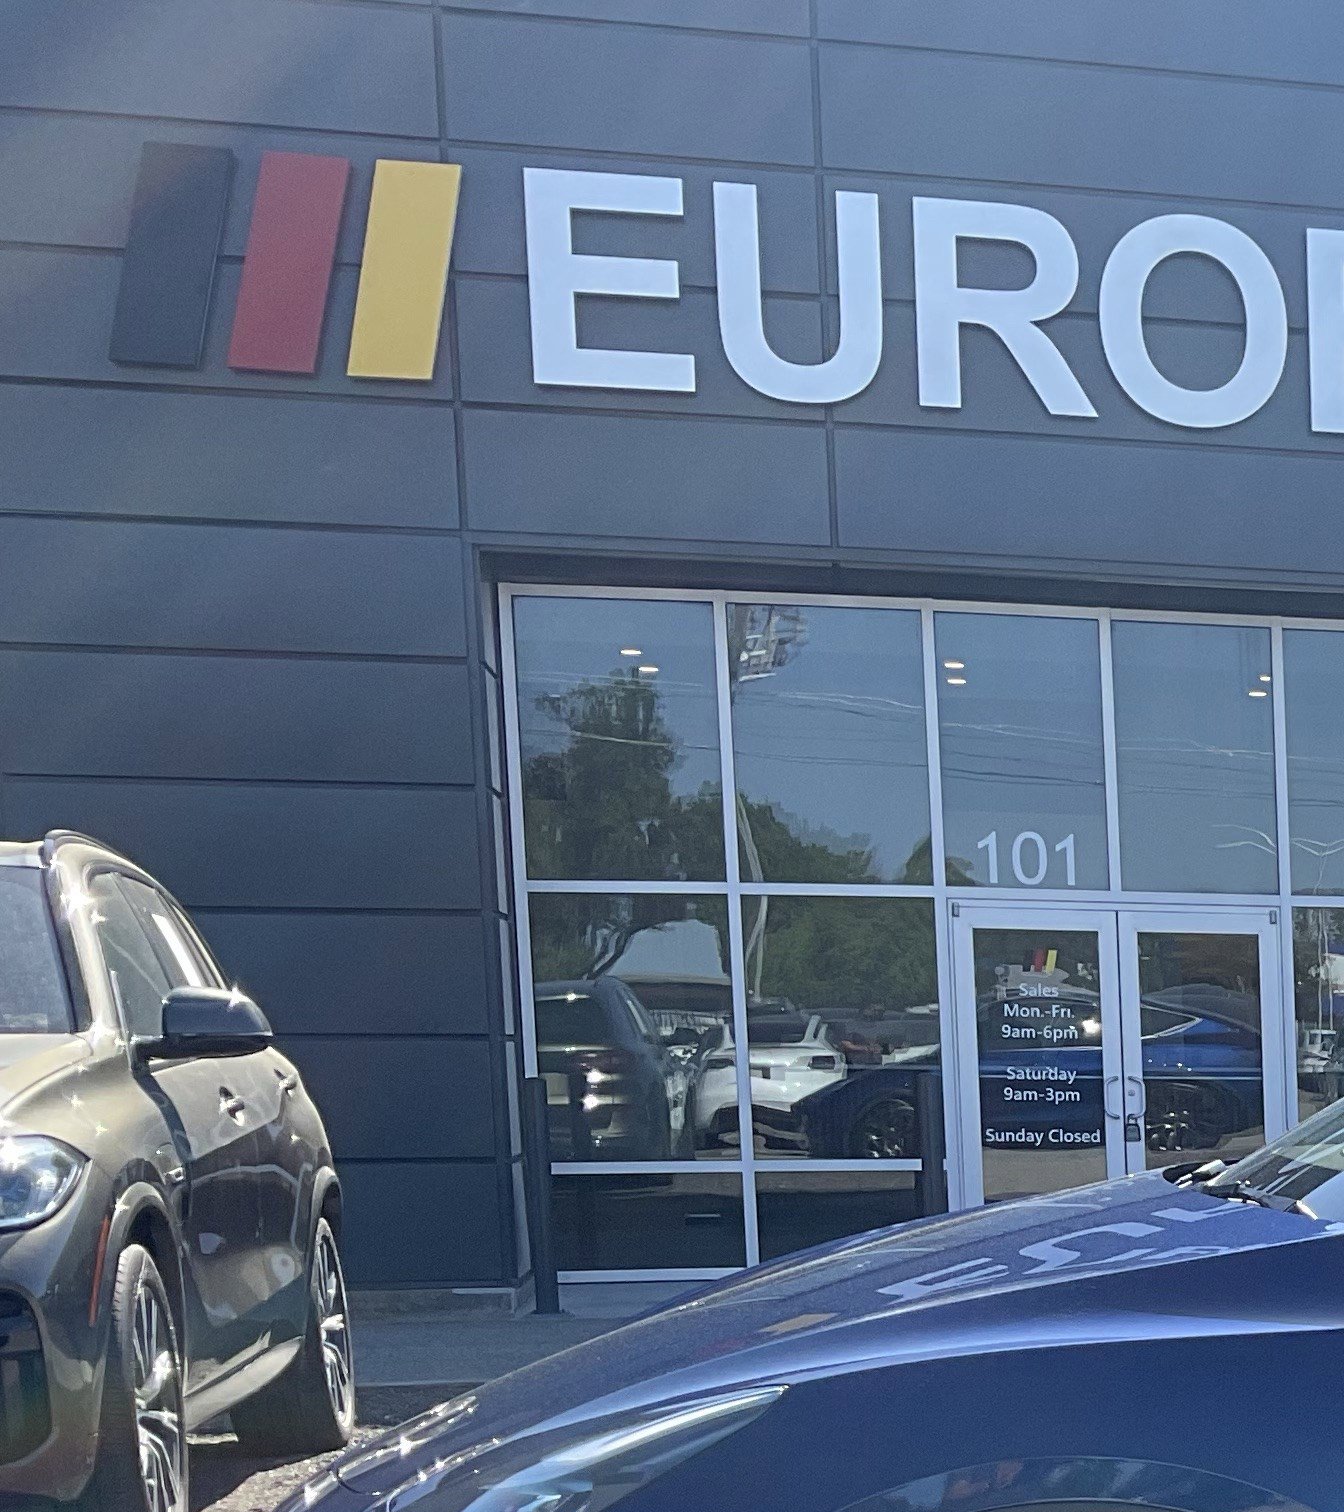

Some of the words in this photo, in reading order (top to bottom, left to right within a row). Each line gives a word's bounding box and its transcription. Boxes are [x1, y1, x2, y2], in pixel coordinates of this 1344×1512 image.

[977, 830, 1076, 886] 101
[1019, 982, 1059, 997] Sales
[1003, 1002, 1075, 1019] Mon.-Fri.
[1001, 1024, 1079, 1043] 9am-6pm
[1006, 1066, 1077, 1085] Saturday
[1003, 1086, 1081, 1105] 9am-3pm
[985, 1127, 1045, 1147] Sunday
[1048, 1128, 1101, 1143] Closed
